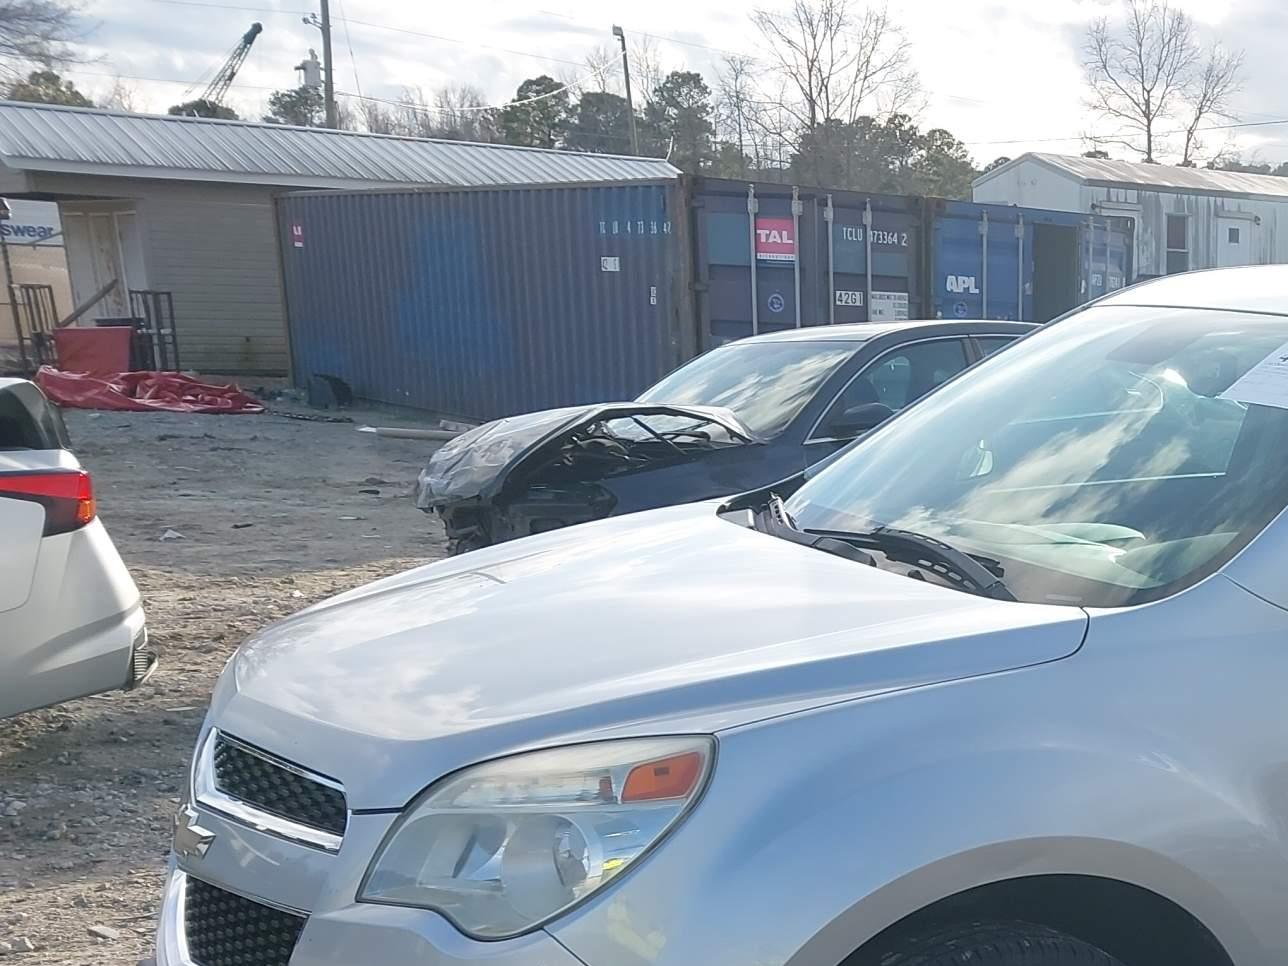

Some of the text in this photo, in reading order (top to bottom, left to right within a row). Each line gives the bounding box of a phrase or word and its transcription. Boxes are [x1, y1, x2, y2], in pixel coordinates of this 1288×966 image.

[757, 229, 794, 244] TAL
[842, 227, 863, 241] TCLU
[946, 275, 979, 294] APL
[837, 292, 862, 304] 42G1
